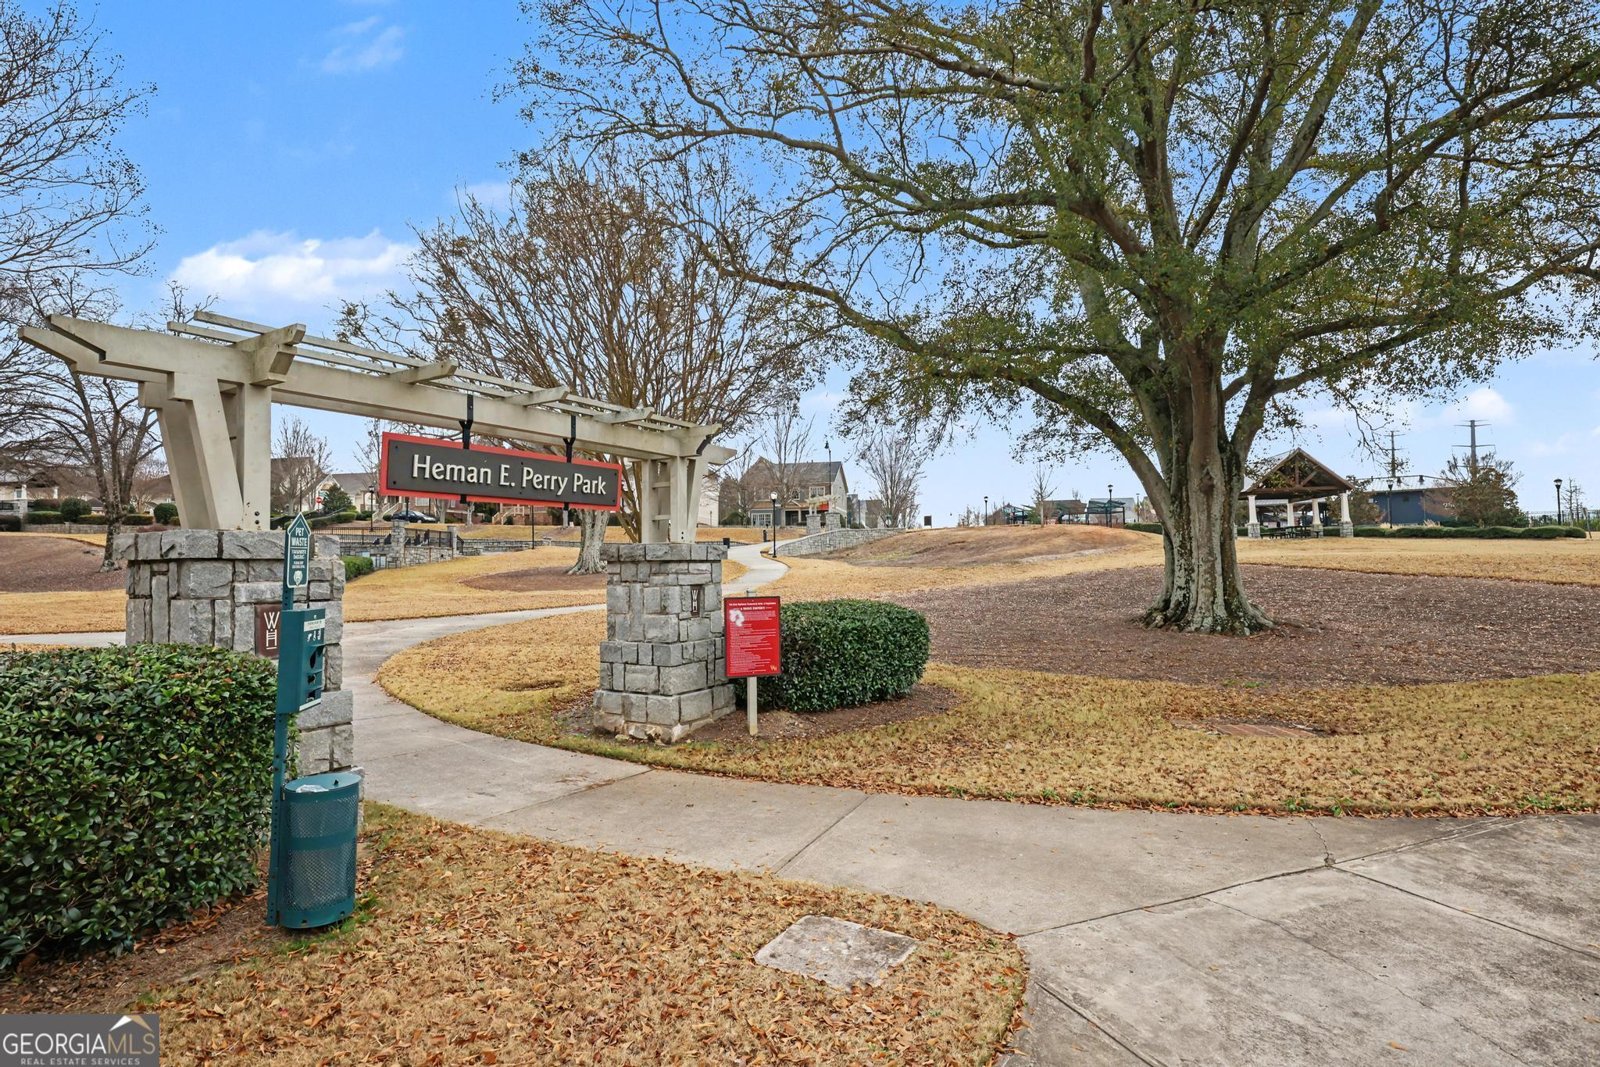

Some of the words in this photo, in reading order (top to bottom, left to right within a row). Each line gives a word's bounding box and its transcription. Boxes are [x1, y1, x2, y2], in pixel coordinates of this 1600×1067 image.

[412, 454, 492, 485] Heman
[500, 464, 516, 487] E.
[522, 466, 569, 496] Perry
[573, 473, 607, 495] Park
[295, 527, 305, 537] PET
[291, 537, 308, 547] WASTE
